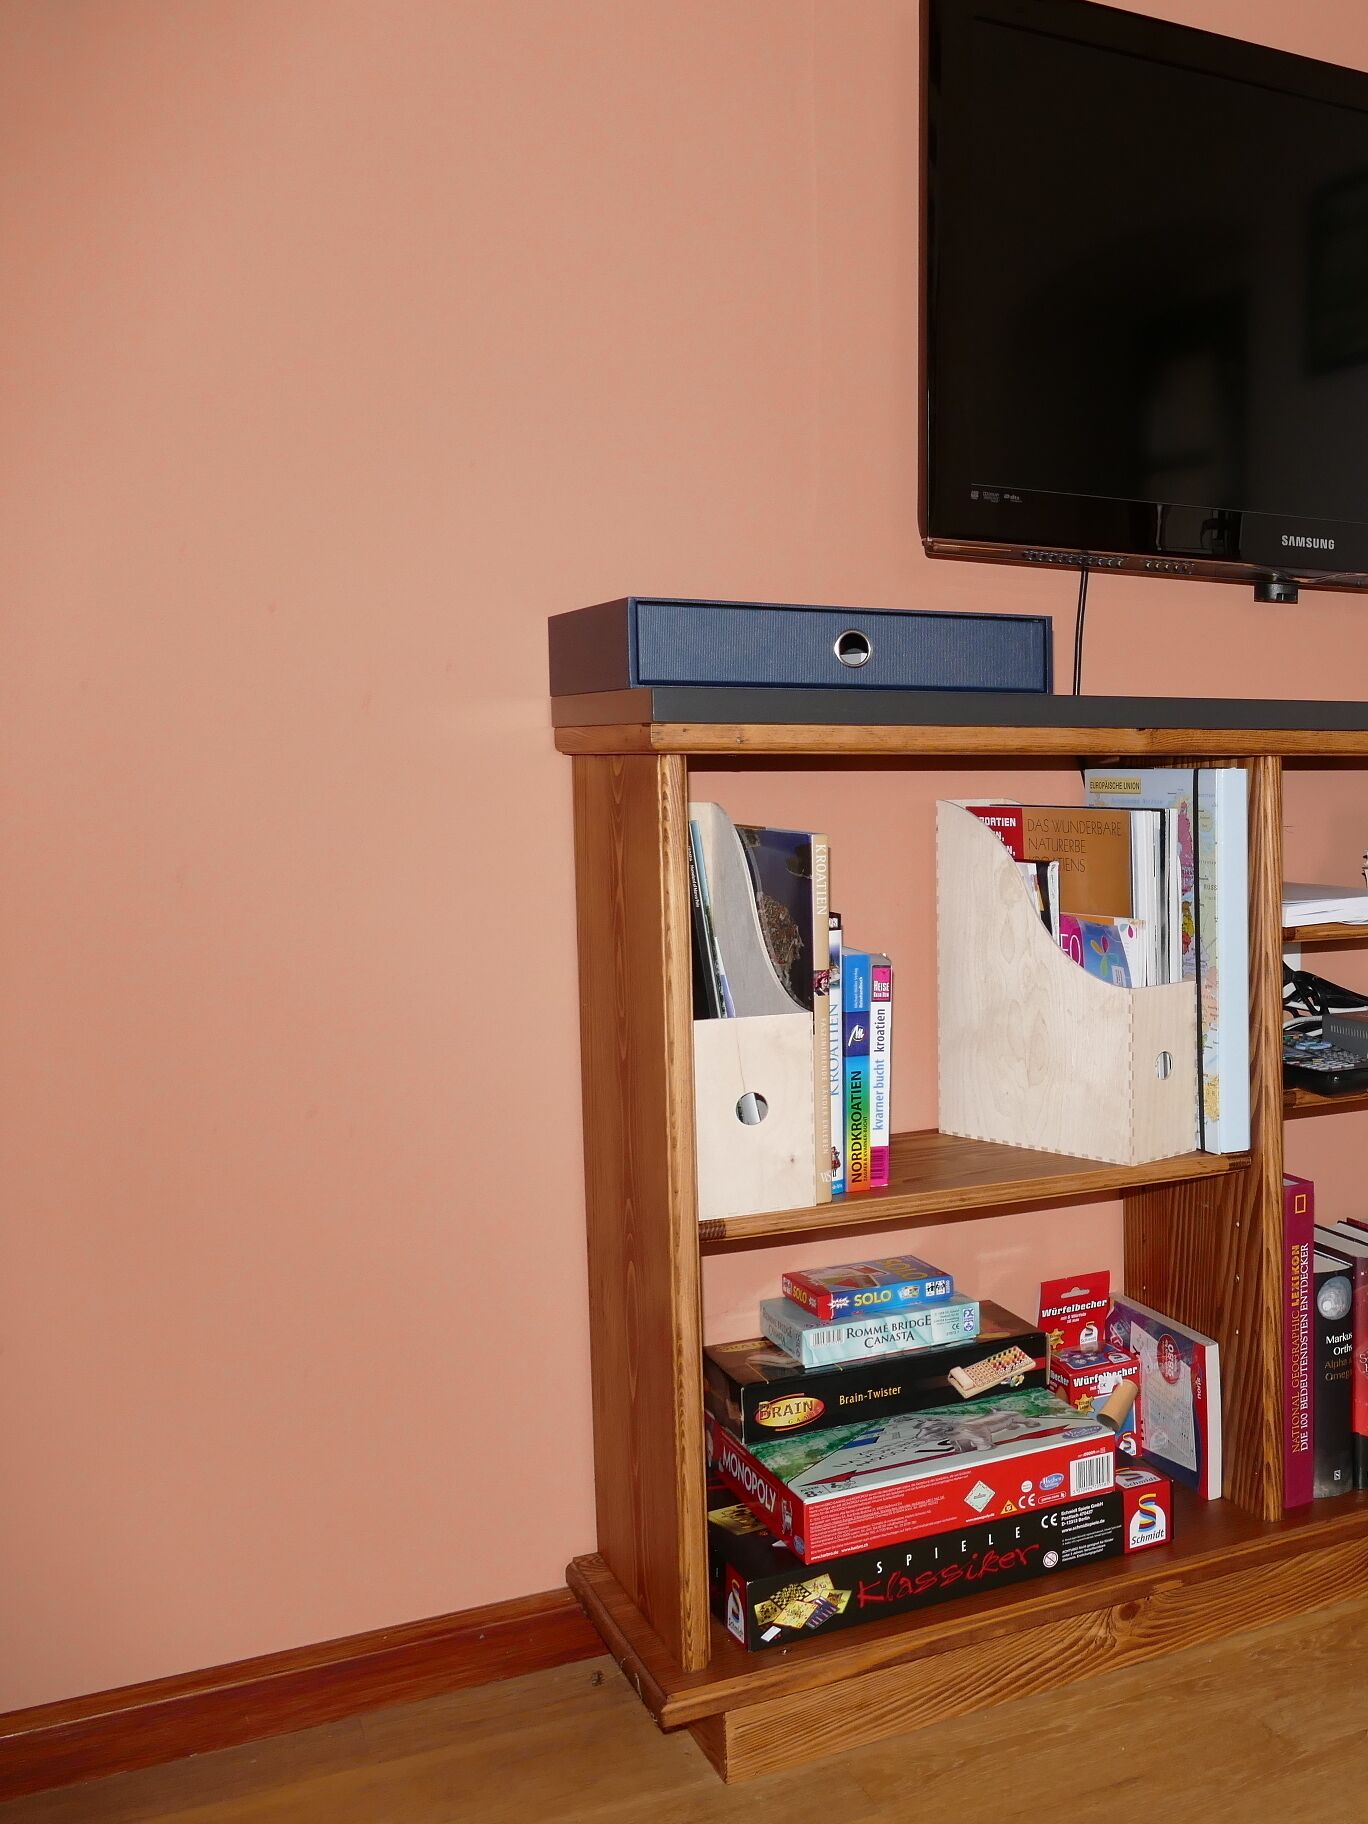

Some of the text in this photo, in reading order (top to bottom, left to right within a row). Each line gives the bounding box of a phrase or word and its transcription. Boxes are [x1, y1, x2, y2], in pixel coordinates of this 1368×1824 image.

[1281, 535, 1335, 550] SAMSUNG
[1090, 781, 1140, 790] EUROPÄISCHE UNION
[1027, 819, 1122, 837] DAS WUNDERBARE
[1028, 837, 1087, 854] NATURERBE
[815, 844, 828, 915] KROATIEN
[829, 1004, 840, 1096] KROATIEN
[873, 1008, 885, 1132] kvarner bucht kroatien
[851, 1067, 863, 1184] NORDKROATIEN
[792, 1286, 808, 1305] SOLO
[854, 1290, 892, 1307] SOLO
[1041, 1299, 1108, 1319] Würfelbecher
[846, 1322, 889, 1340] ROMMÉ
[891, 1314, 931, 1331] BRIDGE
[864, 1331, 915, 1349] CANASTA
[1300, 1242, 1310, 1452] DIE 100 BEDEUTENDSTEN ENTDECKER
[1325, 1332, 1353, 1345] Markus
[1291, 1244, 1301, 1454] NATIONAL GEOGRAPHIC LEXIKON
[1333, 1344, 1353, 1356] Orths
[1324, 1358, 1347, 1370] Alpha
[839, 1386, 902, 1406] Brain-Twister
[758, 1399, 815, 1421] BRAIN
[722, 1446, 776, 1513] MONOPOLY
[1124, 1476, 1158, 1488] Schmidt
[1061, 1507, 1078, 1517] Schmidt
[1091, 1502, 1104, 1510] GmbH
[1041, 1512, 1058, 1529] CE
[1131, 1528, 1165, 1546] Schmidt
[876, 1526, 1021, 1574] SPIELE
[856, 1543, 1040, 1609] Klassiker
